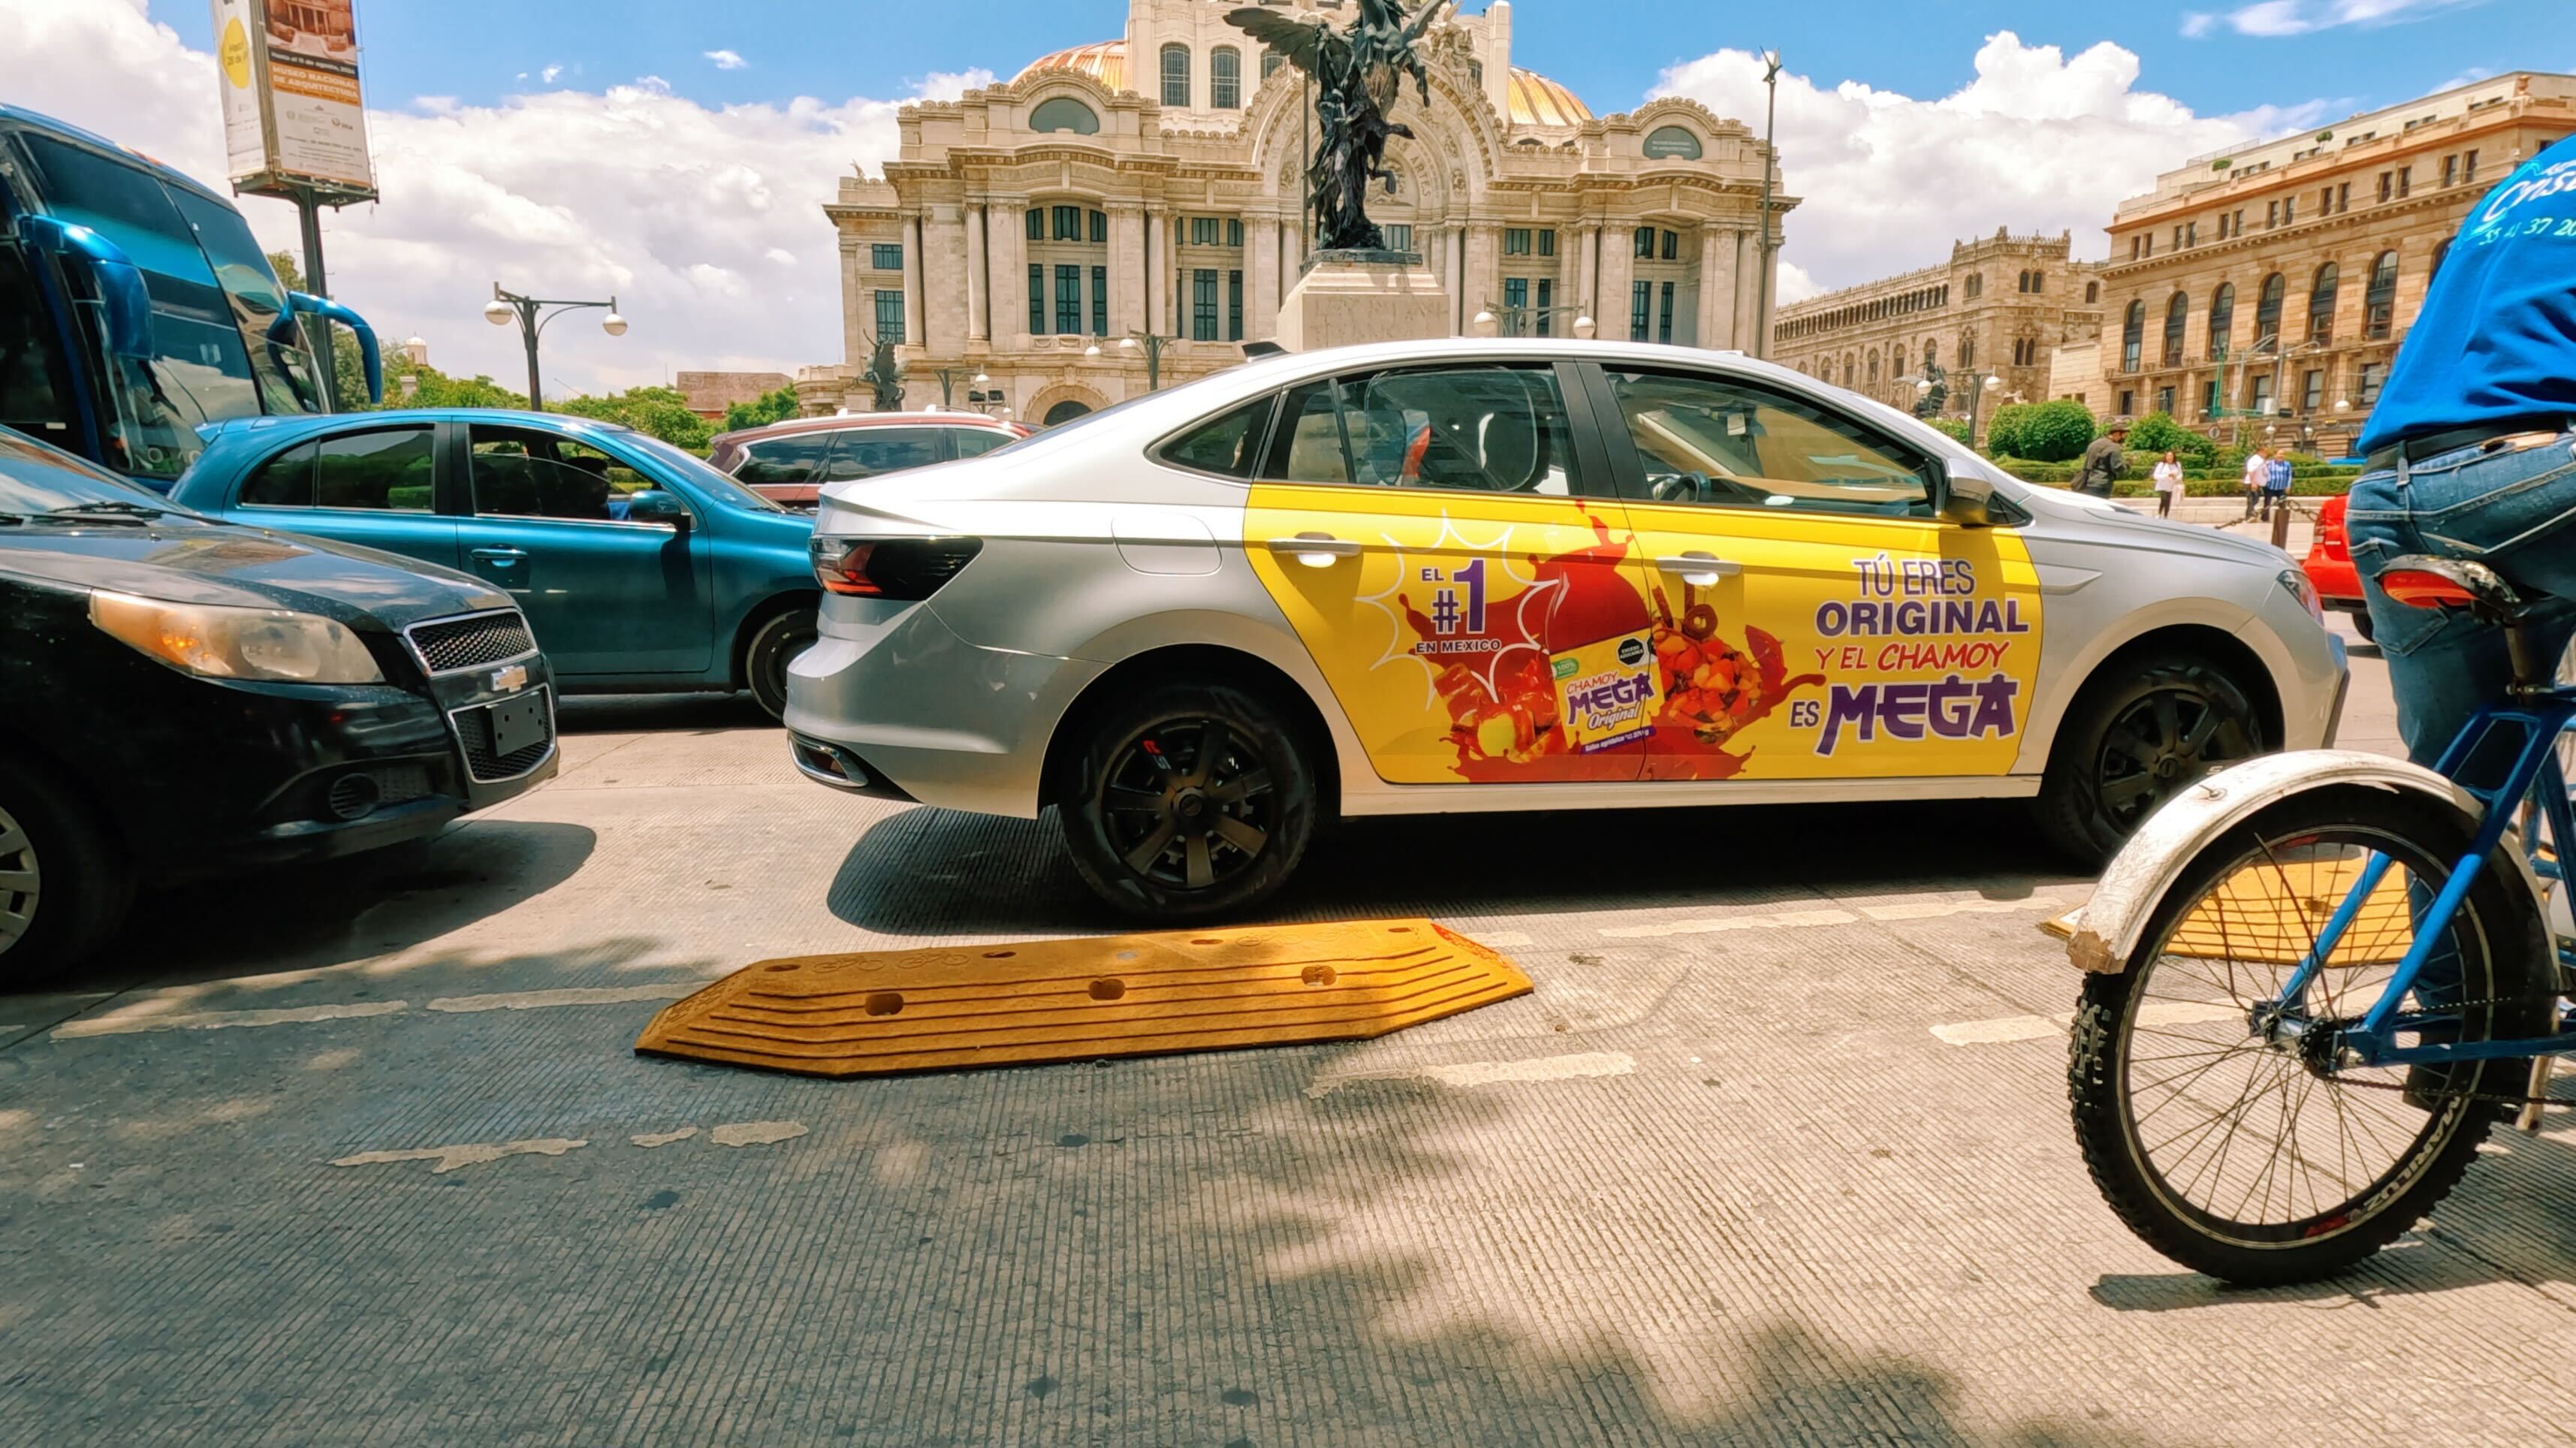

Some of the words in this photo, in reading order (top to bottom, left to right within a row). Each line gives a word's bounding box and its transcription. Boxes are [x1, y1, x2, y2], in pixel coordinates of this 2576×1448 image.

[272, 65, 307, 79] MUSEO
[308, 73, 356, 89] NACIONAL
[273, 74, 285, 84] DE
[288, 79, 358, 98] ARQUITECTURA
[2523, 217, 2553, 234] 37
[1422, 569, 1444, 581] EL
[1853, 554, 1894, 596] TÚ
[1902, 560, 1975, 595] ERES
[1432, 560, 1484, 632] #1
[1816, 600, 2029, 637] ORIGINAL
[1416, 642, 1436, 653] EN
[1442, 640, 1501, 652] MEXICO
[1815, 647, 1835, 670] Y
[1840, 647, 1868, 670] EL
[1877, 641, 2010, 671] CHAMOY
[1567, 671, 1617, 694] CHAMOY
[1567, 673, 1654, 725] MEGA
[1588, 700, 1641, 731] Original
[1790, 701, 1820, 727] ES
[1816, 674, 2018, 756] MEGA
